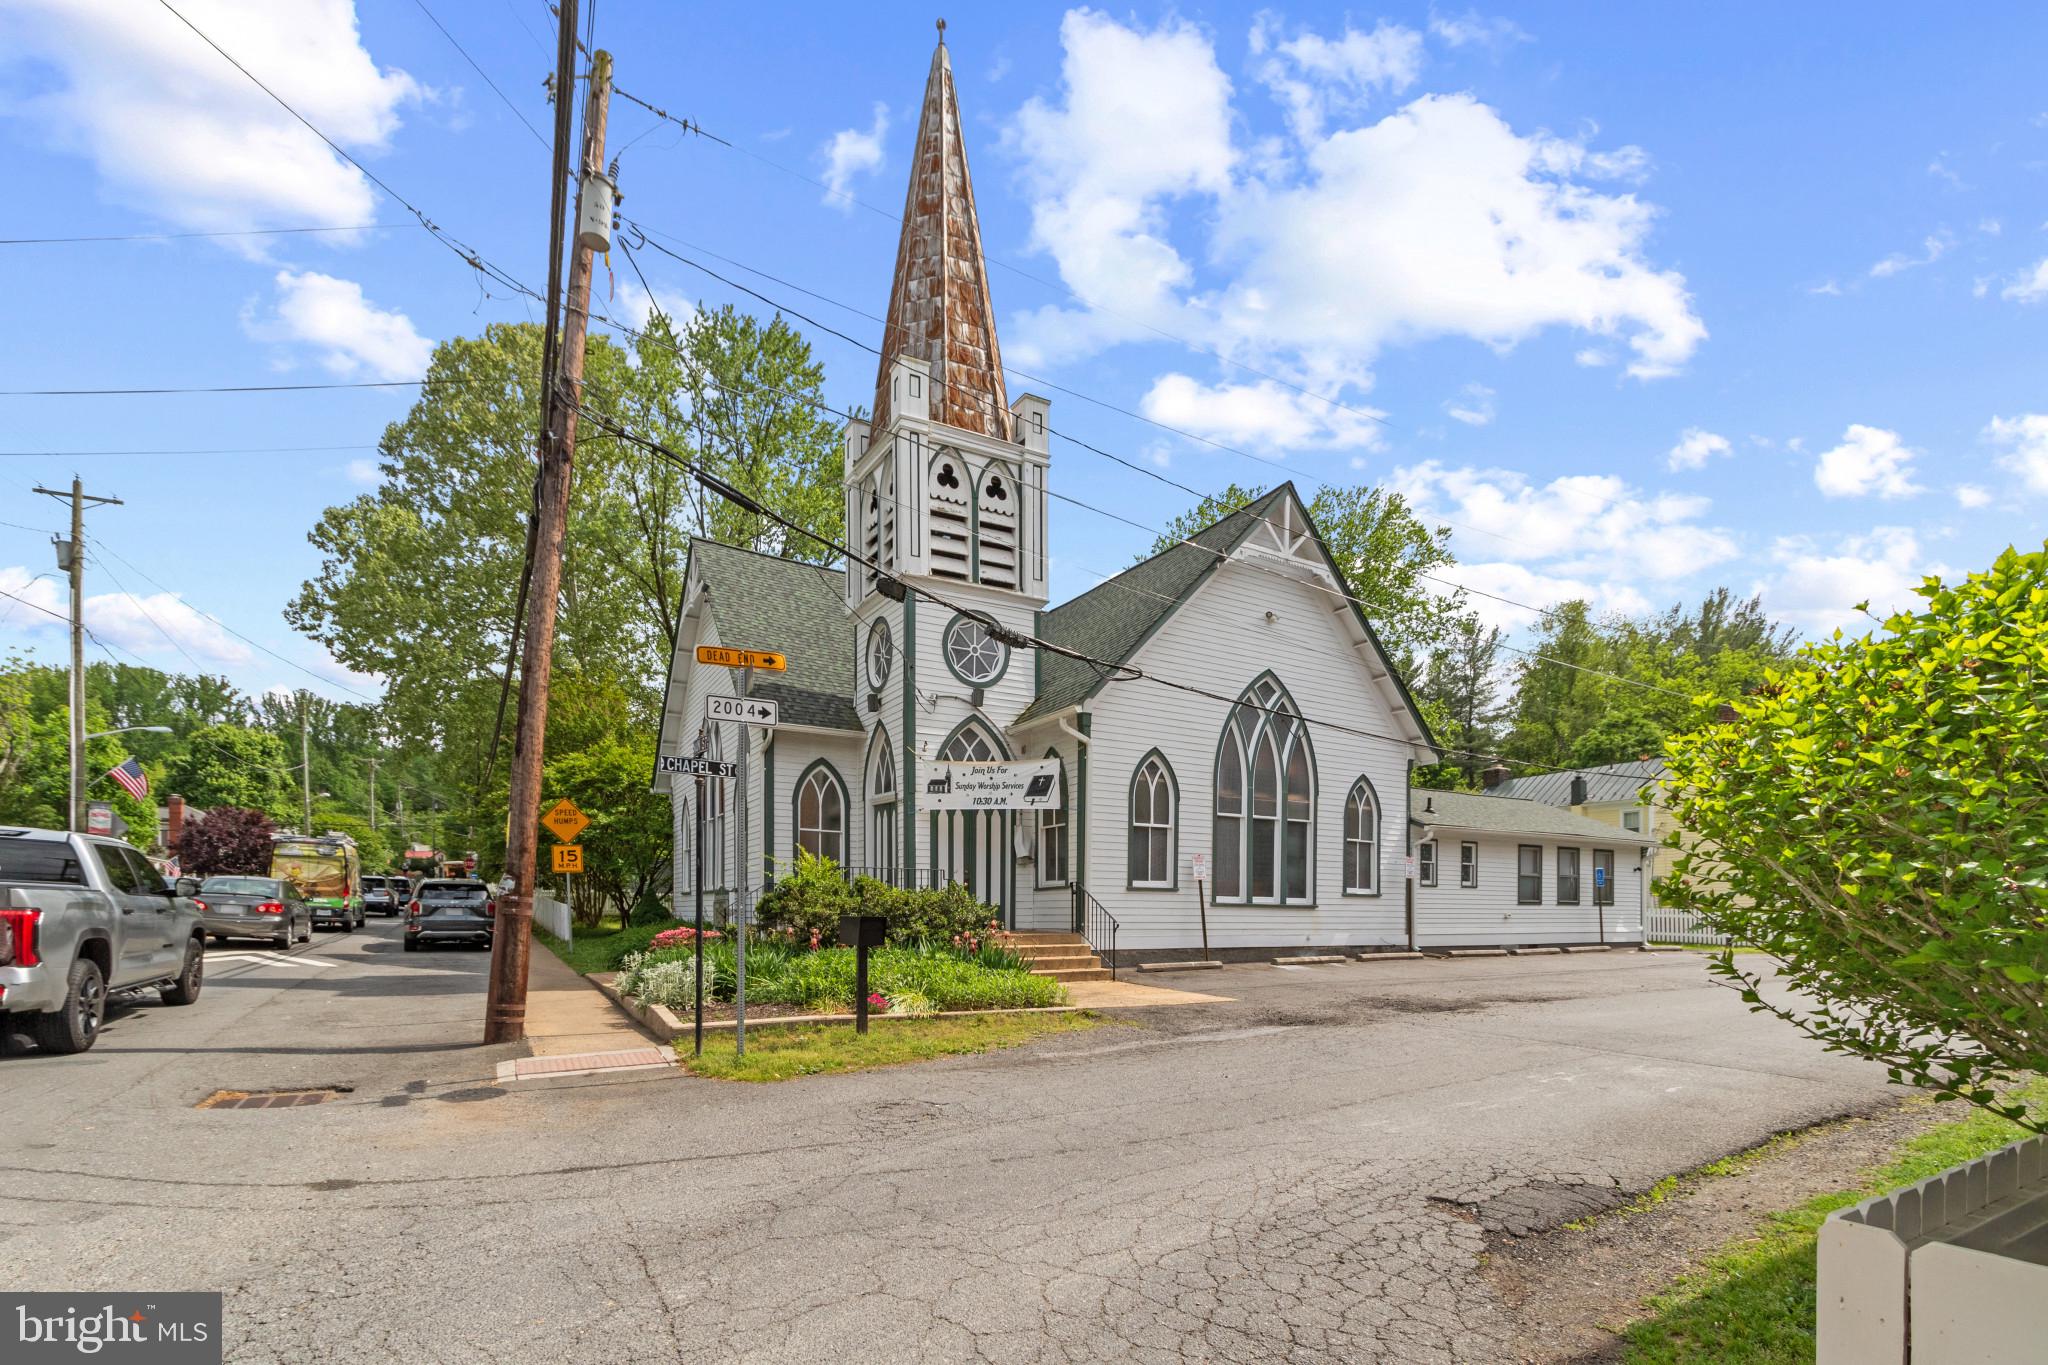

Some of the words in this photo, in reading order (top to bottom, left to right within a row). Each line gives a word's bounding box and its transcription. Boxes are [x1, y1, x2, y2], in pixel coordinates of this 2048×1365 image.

[706, 650, 730, 662] DEAD
[738, 653, 755, 664] END
[713, 700, 755, 717] 2004
[666, 757, 713, 775] CHAPEL
[719, 763, 733, 777] ST
[970, 766, 986, 776] Join
[986, 766, 995, 774] Us
[996, 766, 1008, 774] For
[955, 781, 977, 792] Sunday
[977, 781, 1001, 792] Worship
[1001, 781, 1025, 790] Services
[972, 796, 993, 806] 10:30
[554, 808, 578, 817] SPEED
[553, 817, 578, 825] HUMPS
[559, 850, 578, 862] 15
